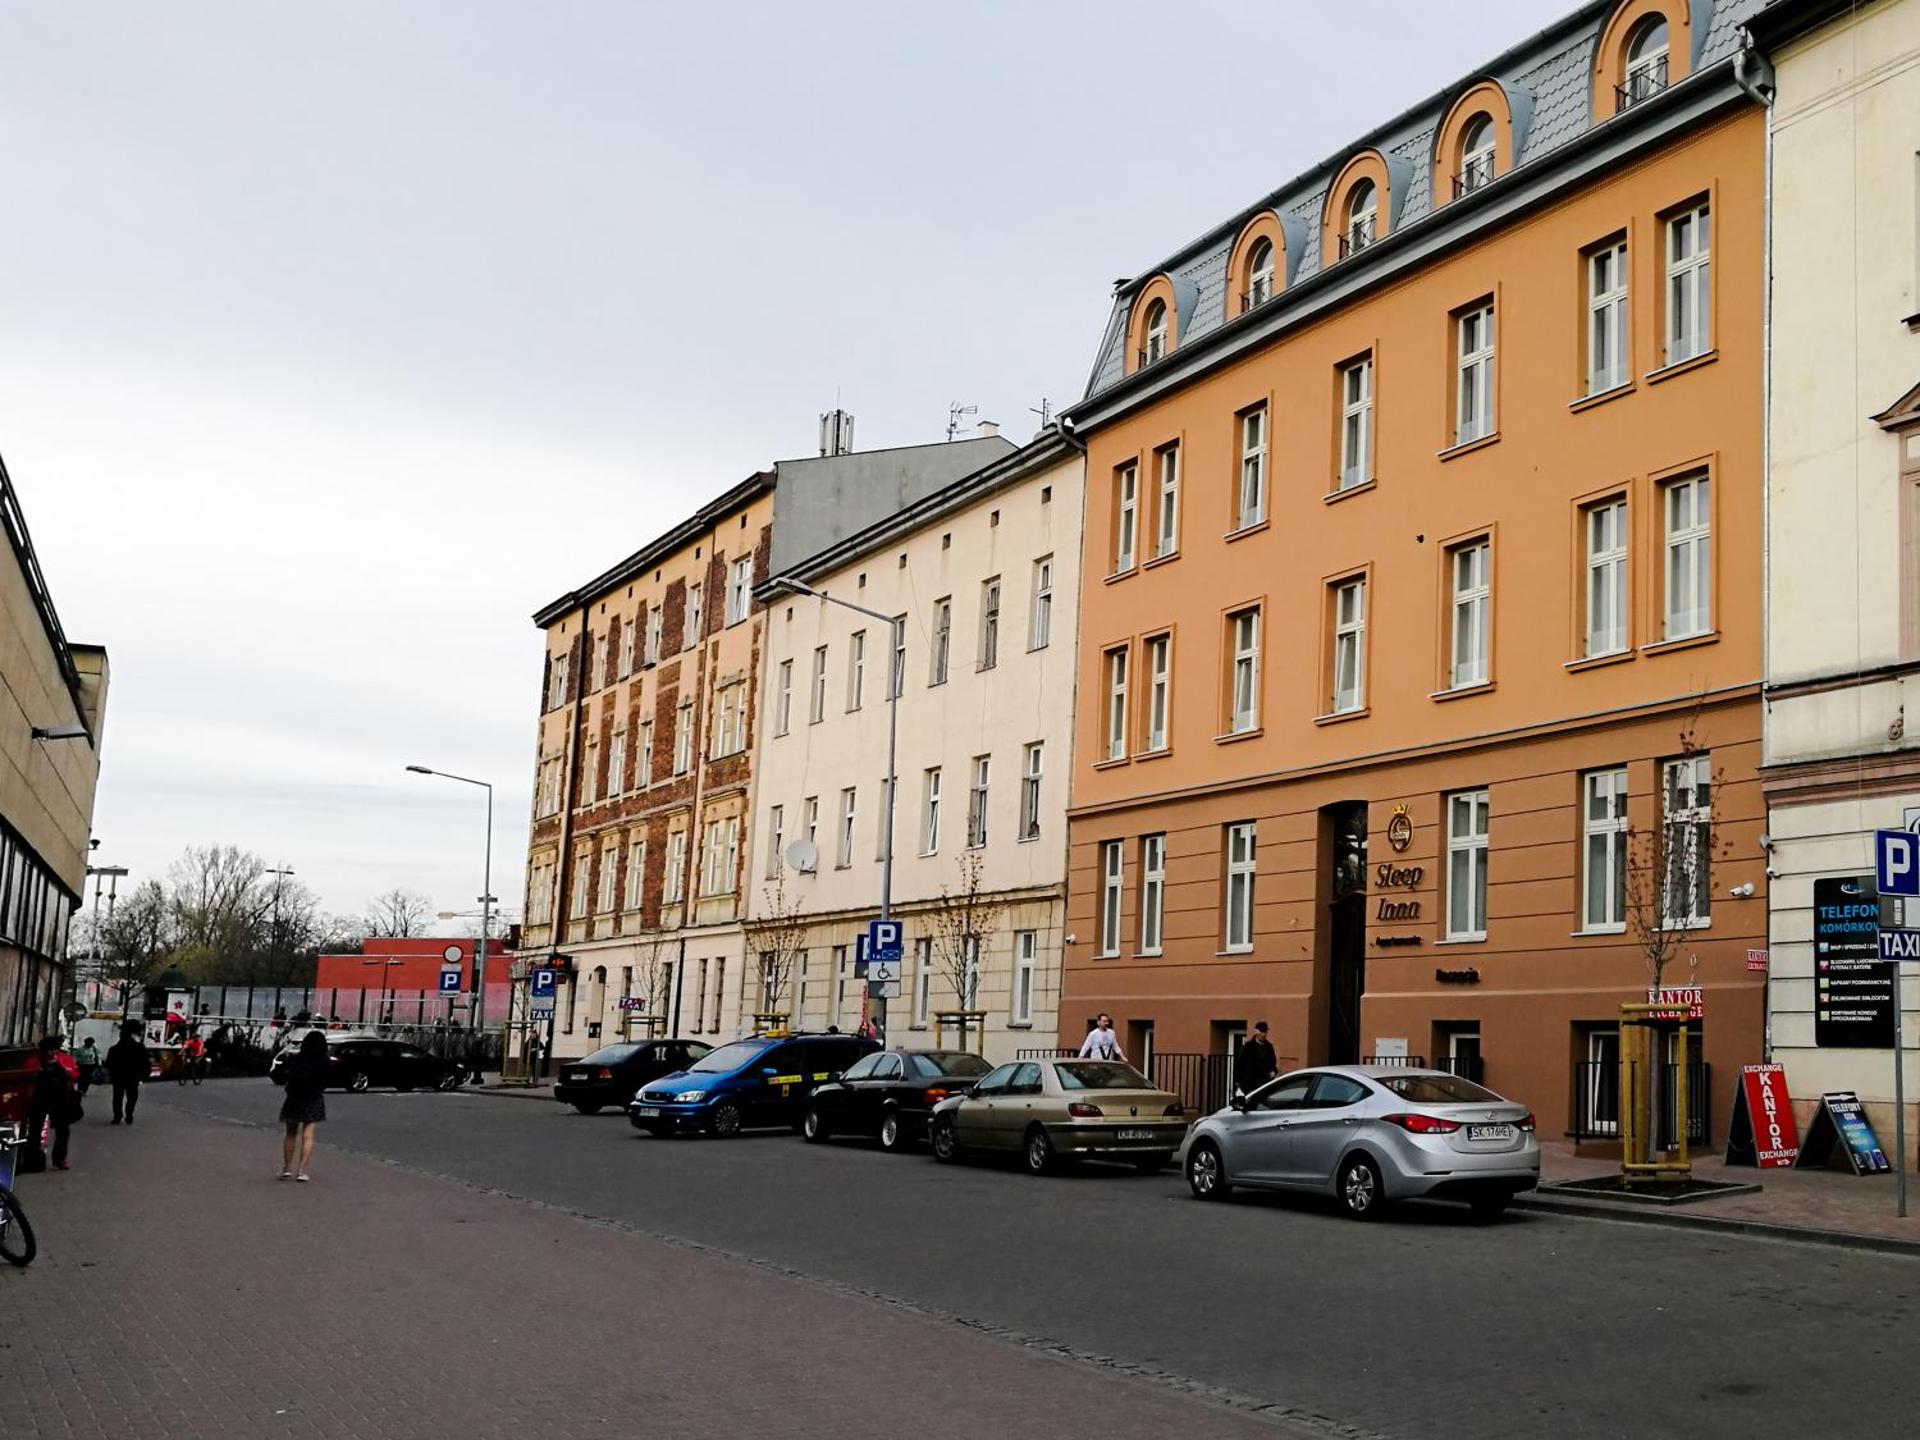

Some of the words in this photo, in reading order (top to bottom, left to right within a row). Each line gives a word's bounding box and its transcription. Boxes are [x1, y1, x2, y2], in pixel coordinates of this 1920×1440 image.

[1885, 837, 1911, 887] P
[1375, 863, 1424, 890] Sleep
[876, 924, 896, 950] P
[1880, 932, 1920, 957] TAXI
[444, 973, 458, 988] P
[537, 972, 553, 989] P
[1649, 990, 1702, 1004] KANTOR
[532, 1010, 554, 1020] TAXI
[1744, 1065, 1783, 1073] EXCHANGE
[1759, 1073, 1783, 1149] KANTOR
[1760, 1148, 1800, 1159] EXCHANGE
